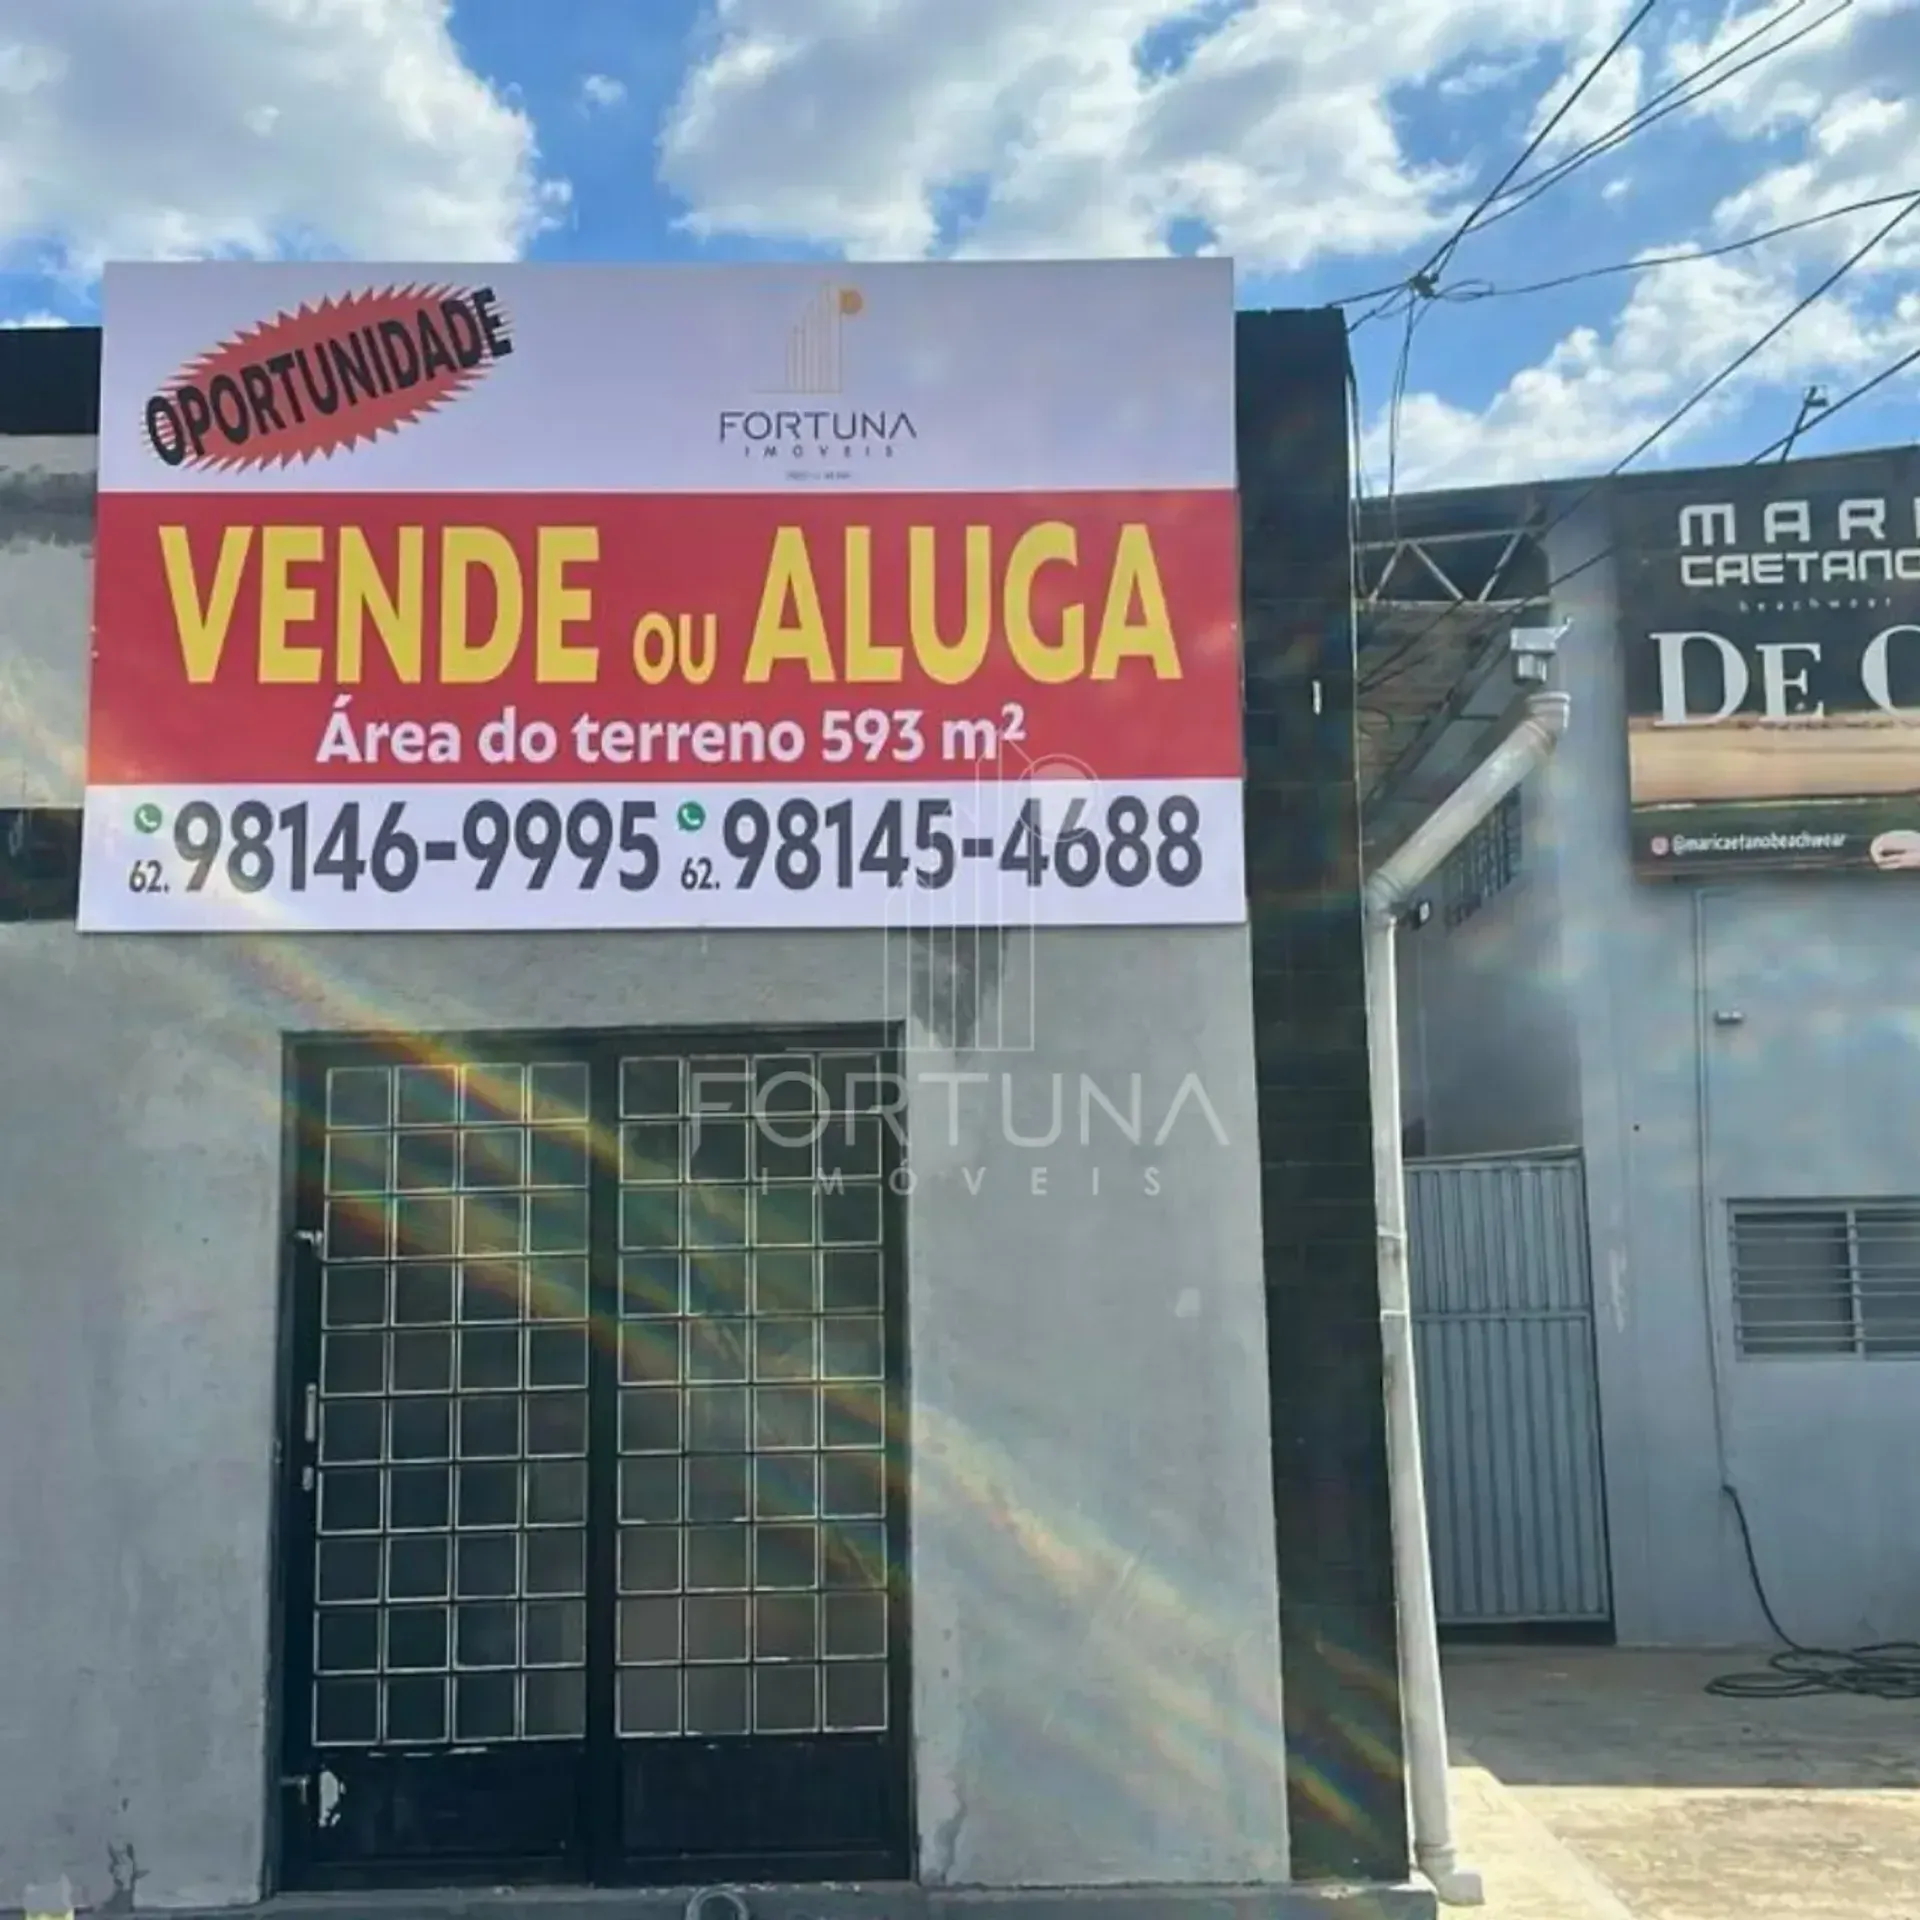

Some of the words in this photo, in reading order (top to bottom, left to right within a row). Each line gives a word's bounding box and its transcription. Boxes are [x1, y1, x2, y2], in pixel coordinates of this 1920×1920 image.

[145, 287, 513, 467] OPORTUNIDADE
[720, 410, 917, 443] FORTUNA
[159, 526, 600, 684] VENDE
[744, 521, 1183, 684] ALUGA
[315, 695, 461, 763] Área
[477, 706, 558, 763] do
[571, 713, 806, 763] terreno
[821, 708, 926, 763] 593
[128, 860, 170, 893] 62.
[173, 798, 661, 893] 98146-9995
[680, 857, 721, 890] 62.
[722, 794, 1203, 889] 98145-4688
[1672, 831, 1847, 855] @maricaetanobeachwear
